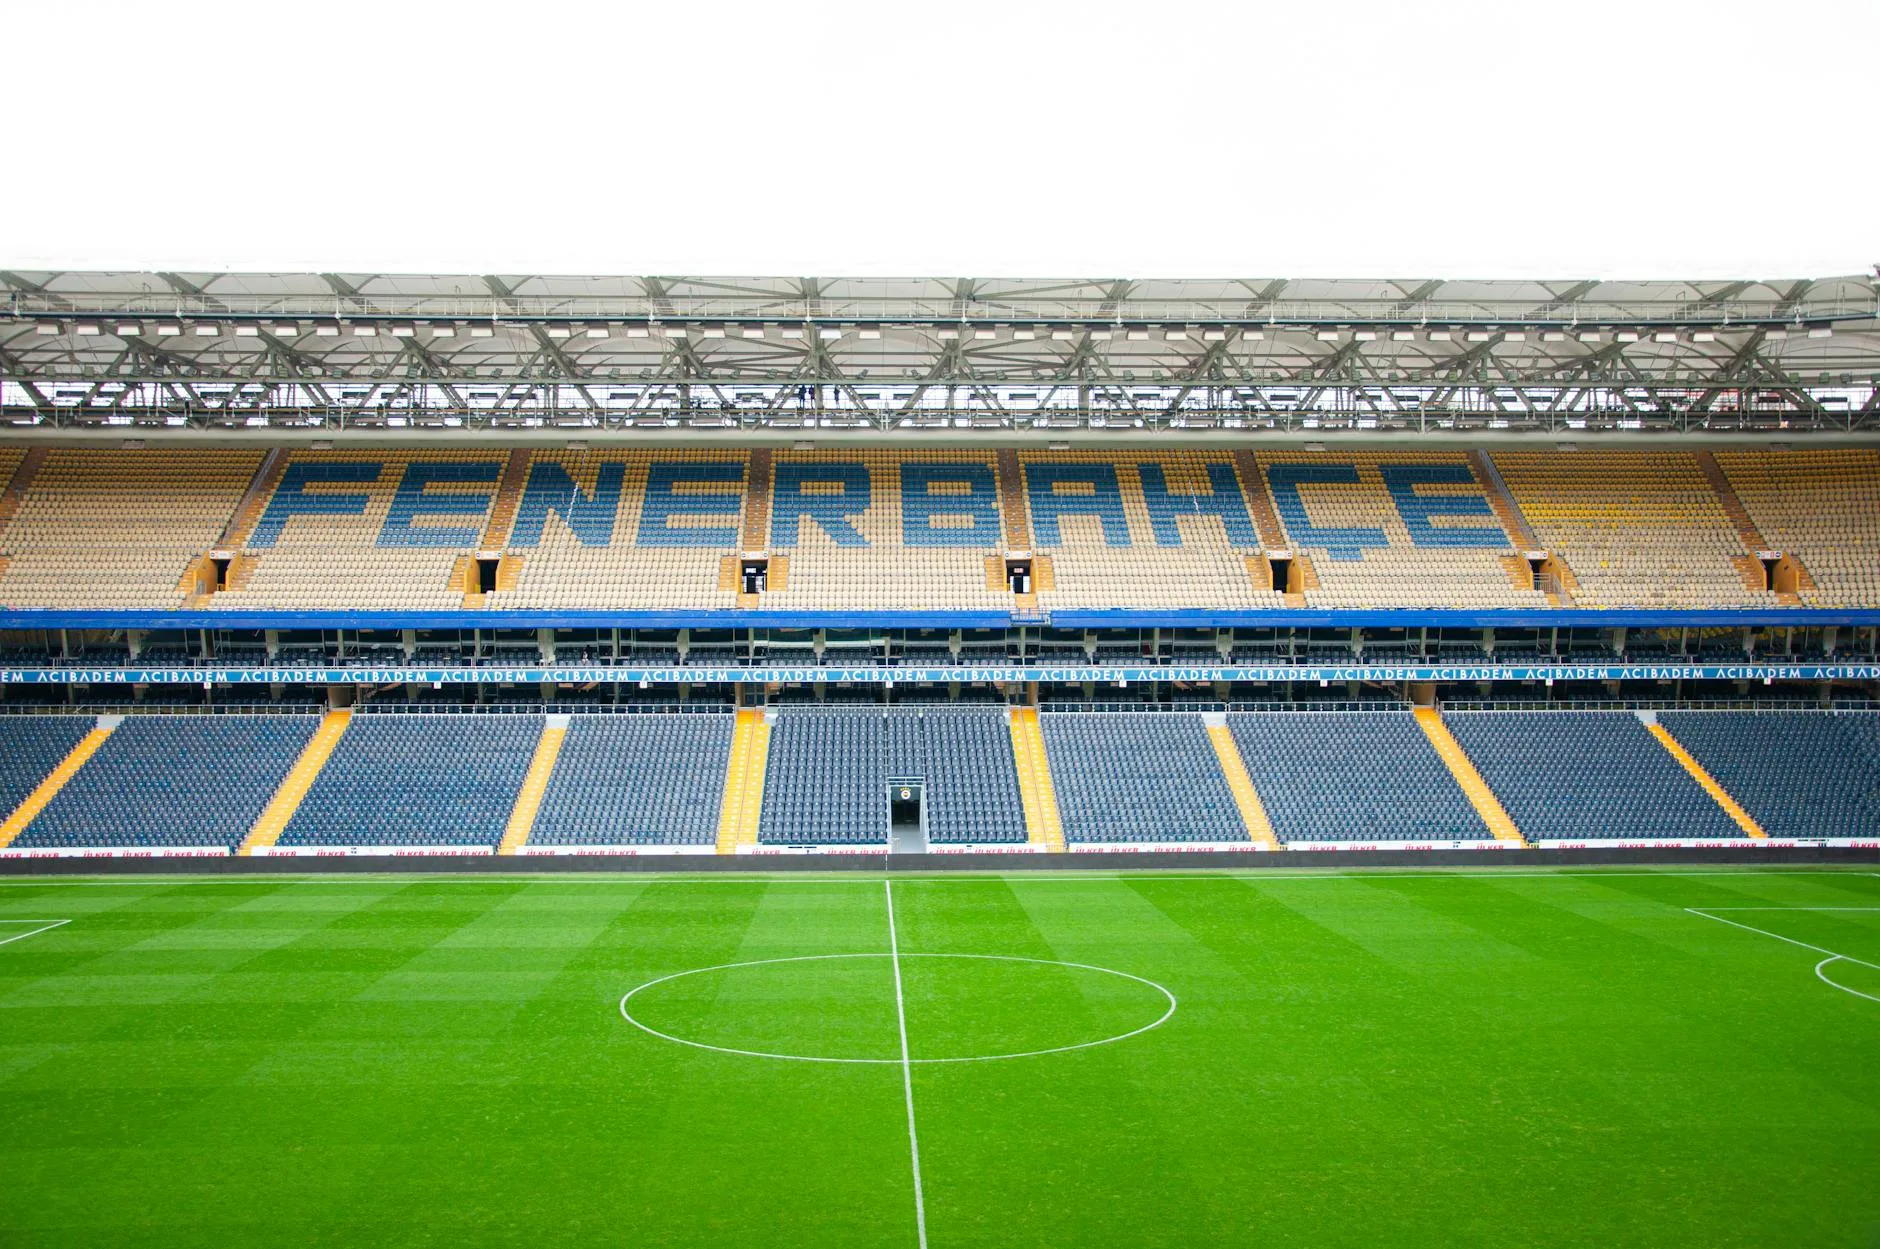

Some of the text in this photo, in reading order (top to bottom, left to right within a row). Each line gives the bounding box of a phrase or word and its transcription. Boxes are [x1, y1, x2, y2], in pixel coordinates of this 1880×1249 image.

[247, 462, 1512, 561] FENERBAHÇE
[38, 671, 125, 682] ACIBADEM
[140, 671, 227, 682] ACIBADEM
[241, 671, 327, 682] ACIBADEM
[341, 671, 426, 681] ACIBADEM
[441, 671, 526, 681] ACIBADEM
[542, 671, 628, 681] ACIBADEM
[642, 670, 728, 681] ACIBADEM
[741, 670, 827, 681] ACIBADEM
[841, 670, 927, 681] ACIBADEM
[940, 670, 1026, 680] ACIBADEM
[1039, 669, 1124, 680] ACIBADEM
[1138, 669, 1222, 680] ACIBADEM
[1238, 669, 1320, 680] ACIBADEM
[1335, 669, 1416, 679] ACIBADEM
[1431, 668, 1512, 679] ACIBADEM
[1526, 668, 1607, 679] ACIBADEM
[1622, 668, 1703, 678] ACIBADEM
[1718, 668, 1799, 678] ACIBADEM
